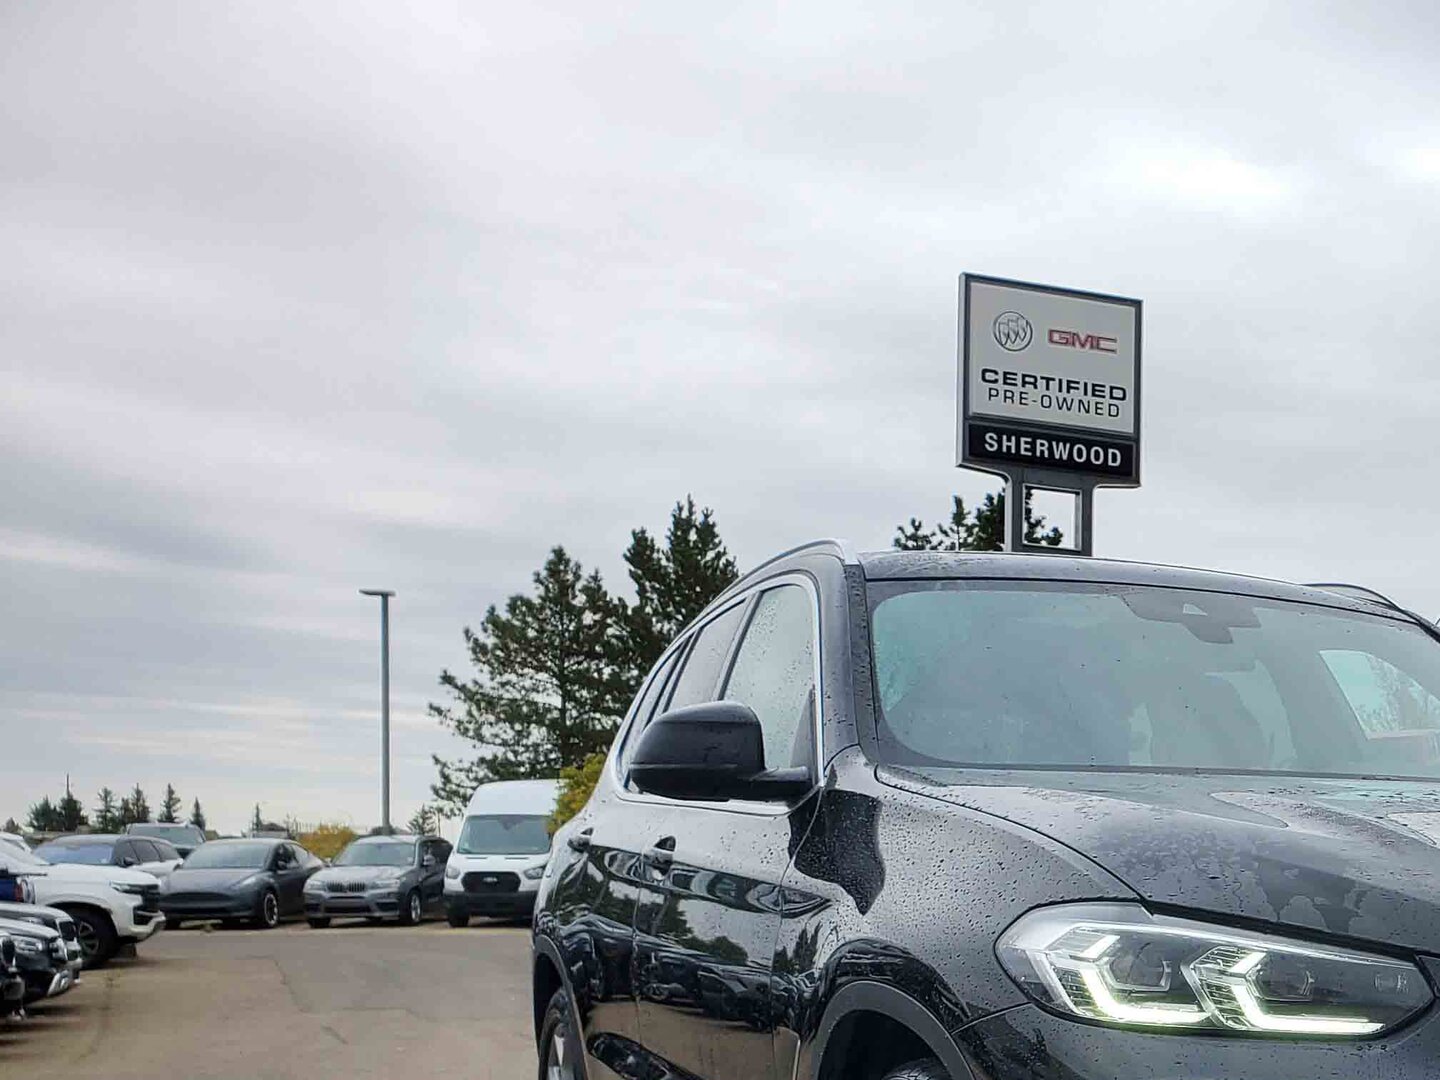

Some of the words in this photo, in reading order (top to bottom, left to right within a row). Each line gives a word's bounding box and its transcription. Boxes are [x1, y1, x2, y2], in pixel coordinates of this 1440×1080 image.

[1048, 328, 1118, 354] GMC
[981, 368, 1127, 401] CERTIFIED
[988, 387, 1120, 418] PRE-OWNED
[984, 432, 1122, 467] SHERWOOD
